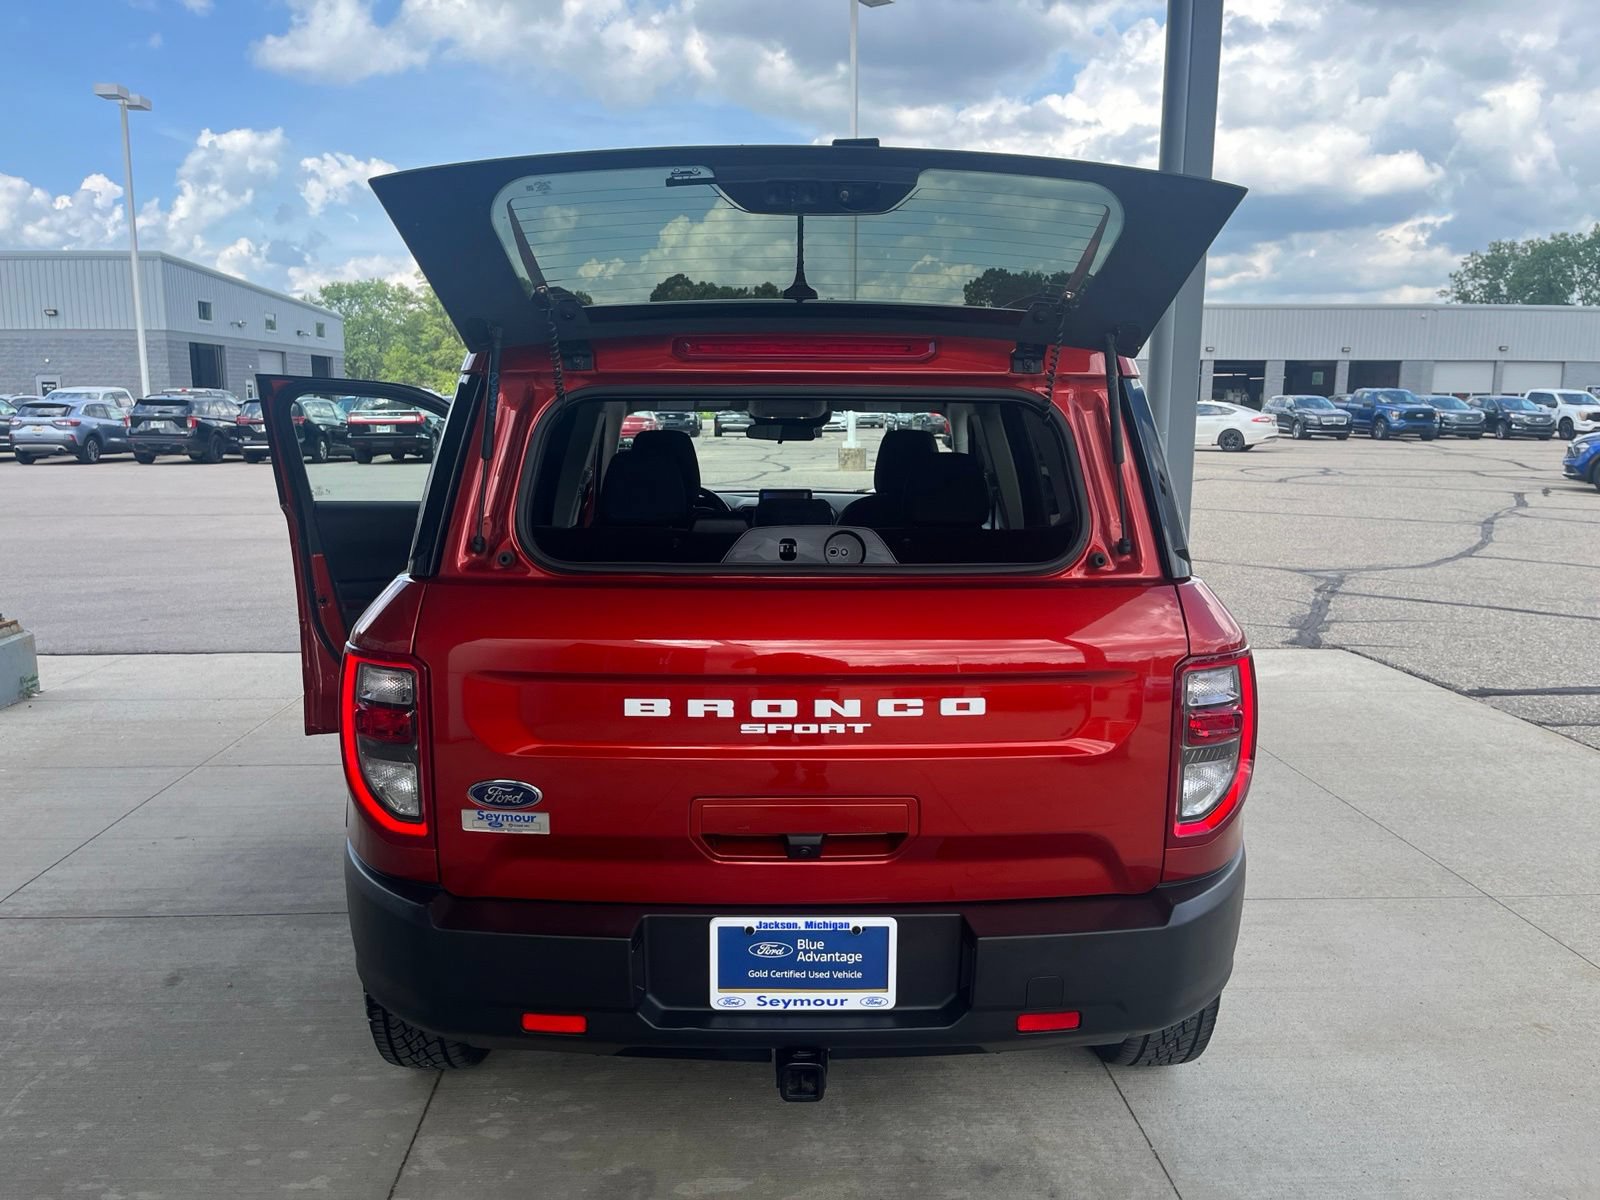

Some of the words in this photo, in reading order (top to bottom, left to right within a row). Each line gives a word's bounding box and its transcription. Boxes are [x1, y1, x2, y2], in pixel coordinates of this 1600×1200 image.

[624, 698, 986, 718] BRONCO
[740, 723, 872, 734] SPORT
[484, 786, 524, 804] Ford
[476, 810, 537, 823] Seymour
[804, 921, 850, 931] Michigan
[756, 943, 785, 956] Ford
[797, 939, 825, 950] Blue
[796, 951, 863, 964] Advantage
[748, 969, 769, 978] Gold
[770, 969, 806, 978] Certified
[808, 970, 830, 979] Used
[832, 970, 863, 979] Vehicle
[756, 995, 849, 1009] Seymour
